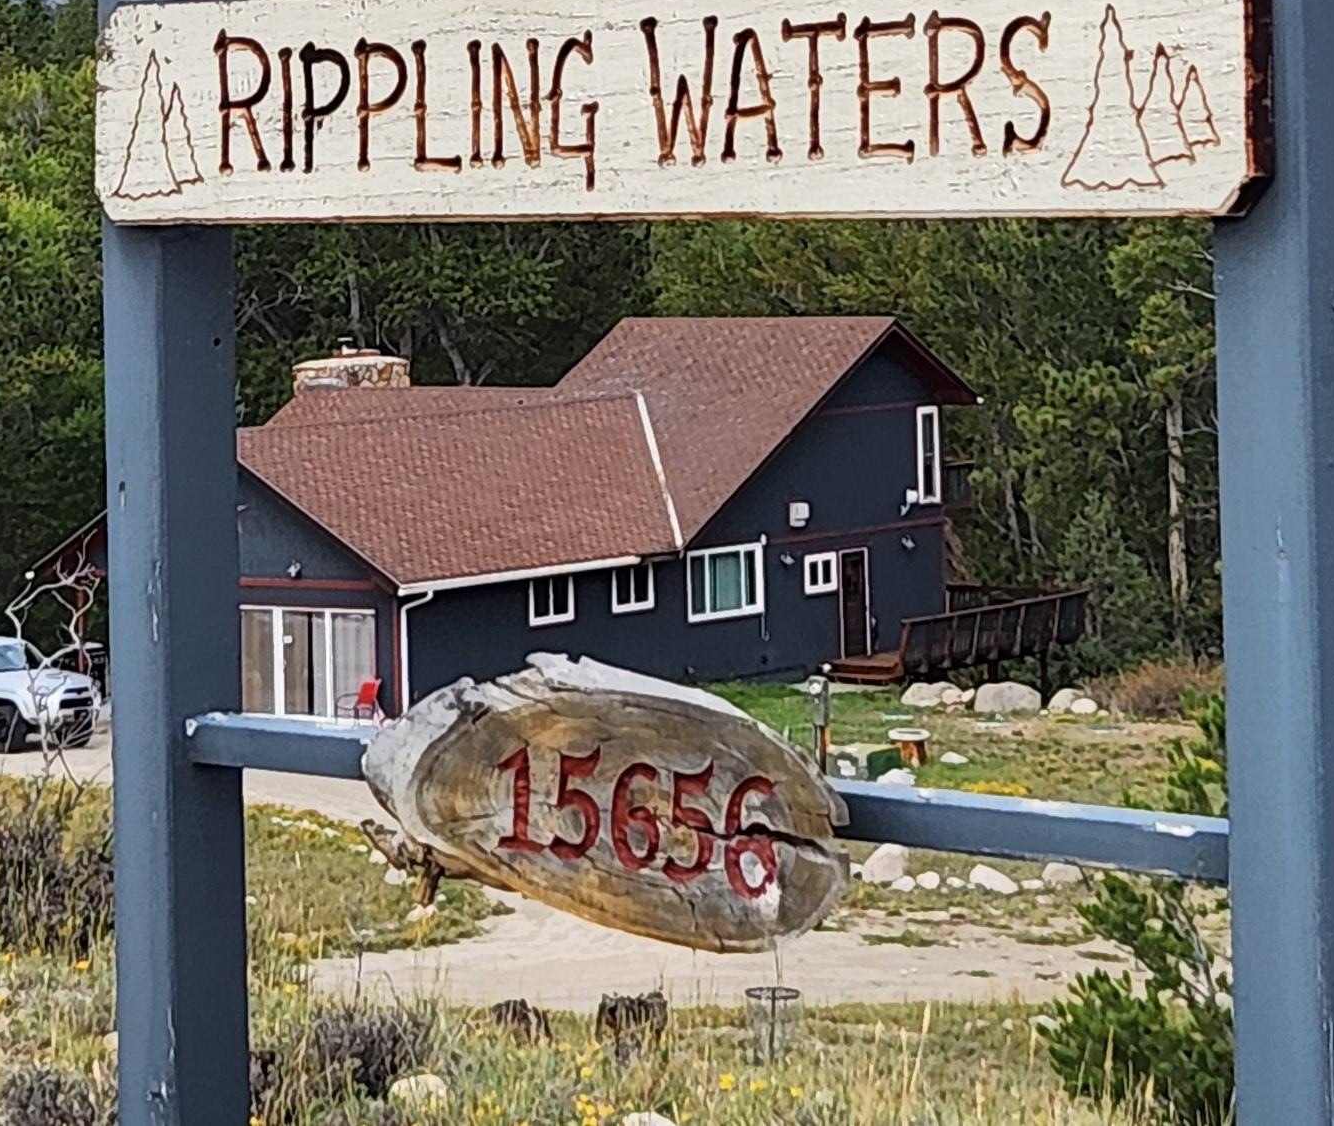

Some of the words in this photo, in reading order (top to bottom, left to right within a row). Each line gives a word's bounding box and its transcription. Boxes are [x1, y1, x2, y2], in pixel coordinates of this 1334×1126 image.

[214, 28, 598, 192] RIPPLING
[640, 11, 1052, 166] WATERS
[496, 745, 779, 899] 15656
